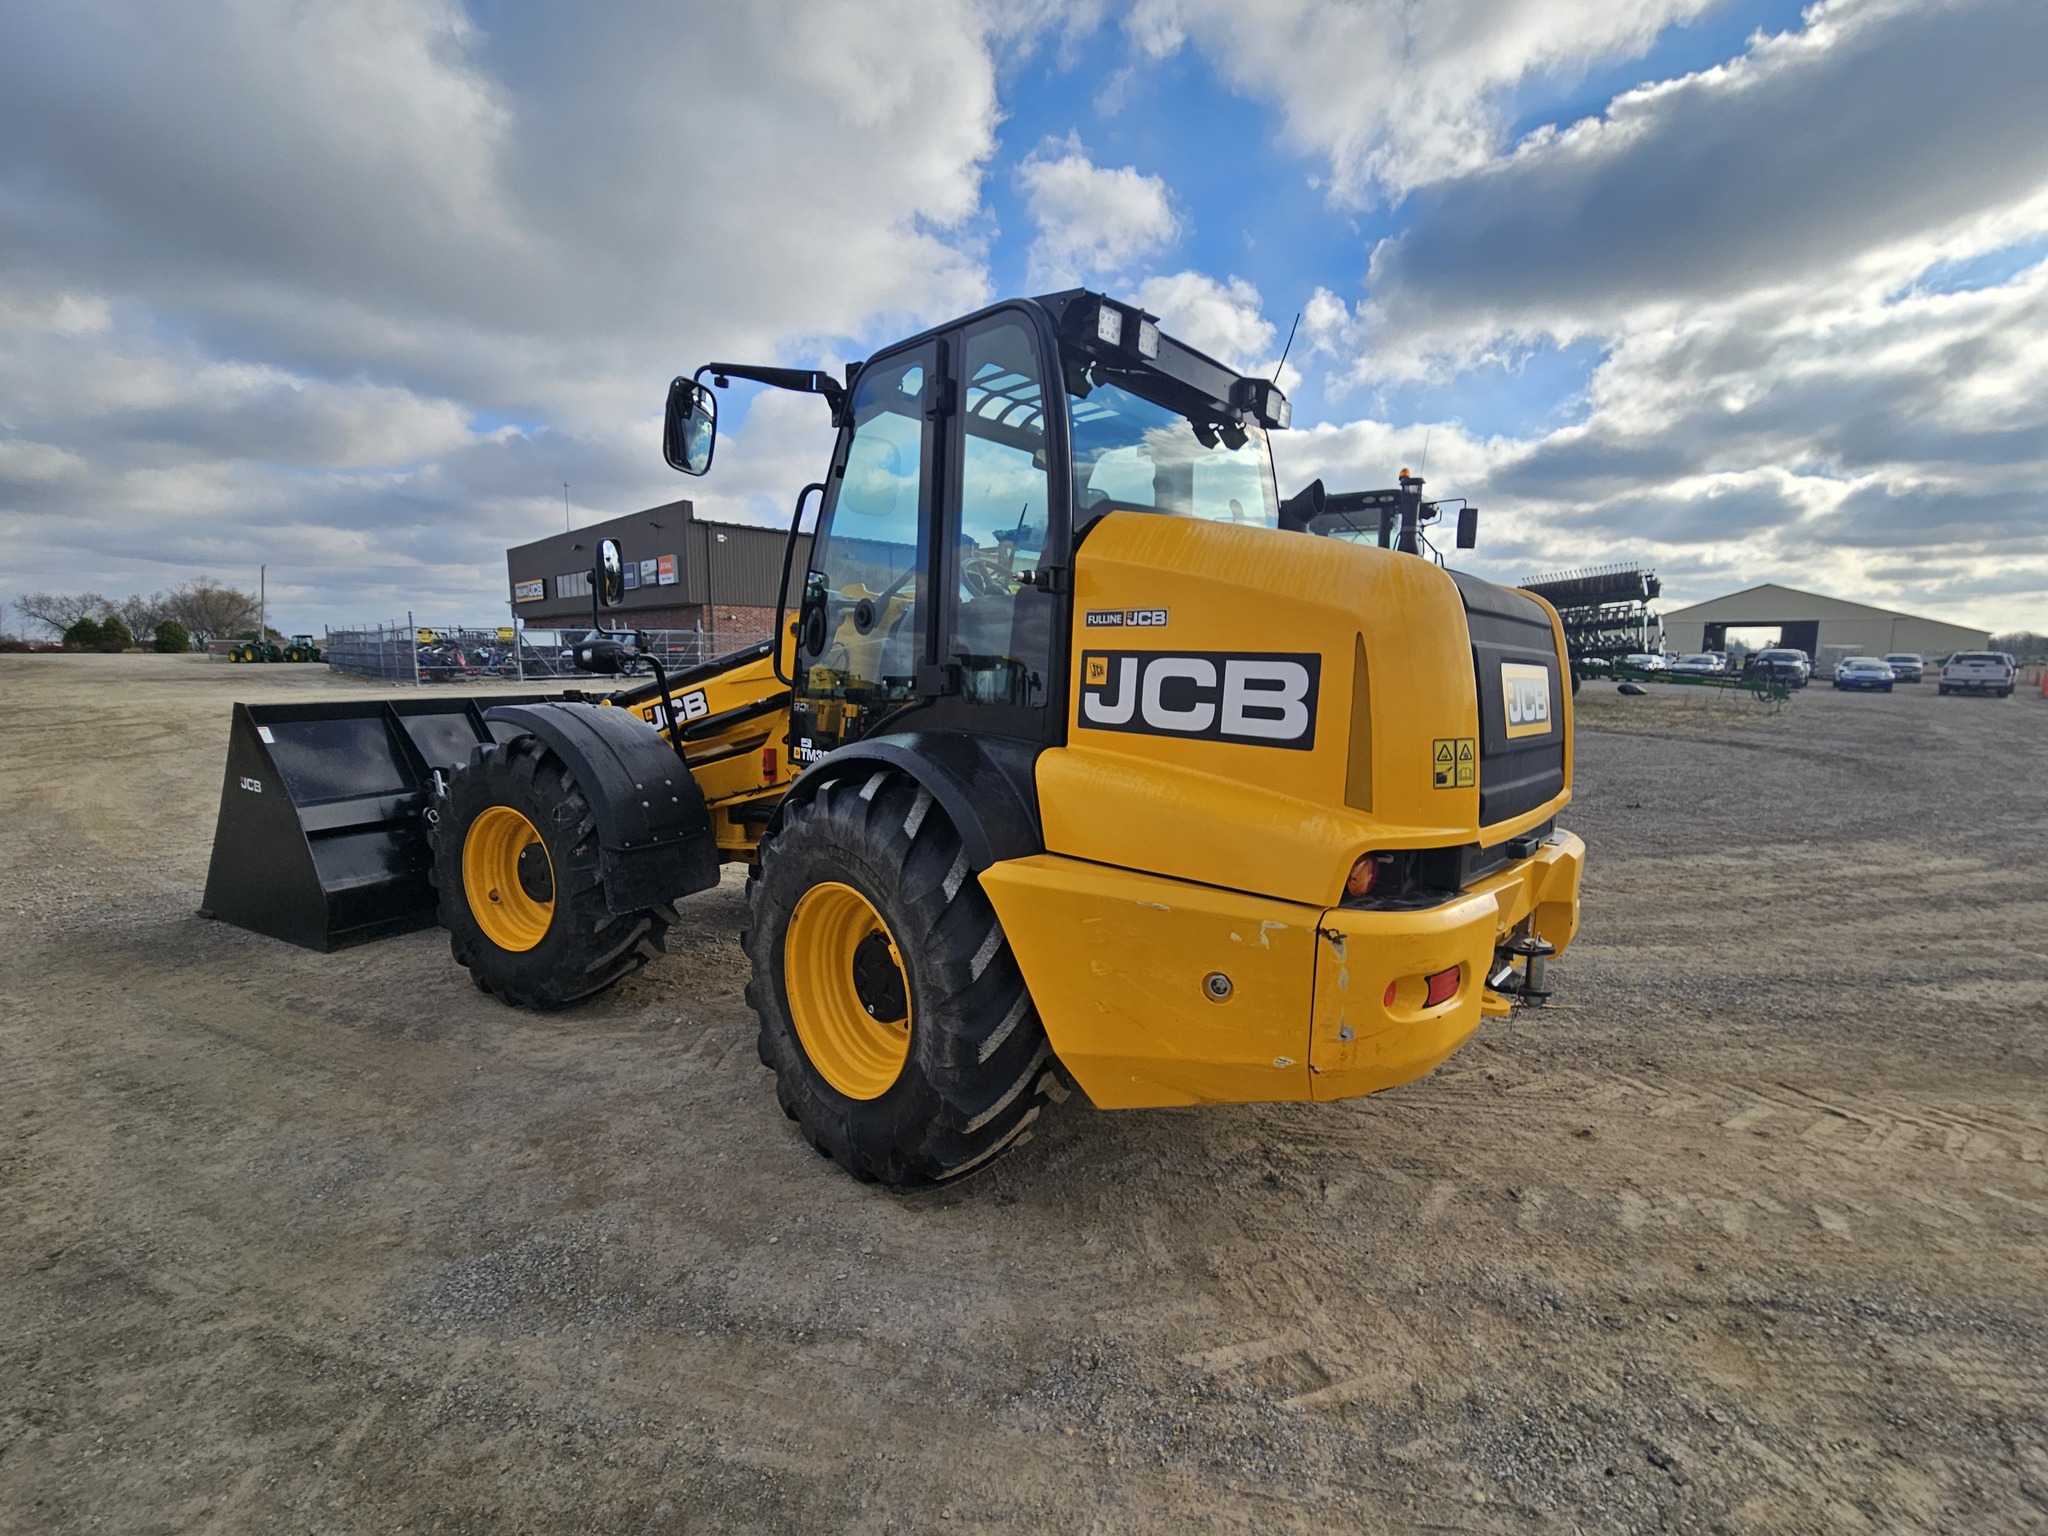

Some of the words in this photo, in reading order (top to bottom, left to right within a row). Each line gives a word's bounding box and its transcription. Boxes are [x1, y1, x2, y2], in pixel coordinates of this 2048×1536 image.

[1087, 614, 1122, 624] FULLINE
[1127, 611, 1166, 626] JCB
[645, 691, 708, 731] JCB
[1084, 657, 1309, 739] JCB
[1508, 682, 1547, 723] JCB
[240, 776, 262, 793] JCB
